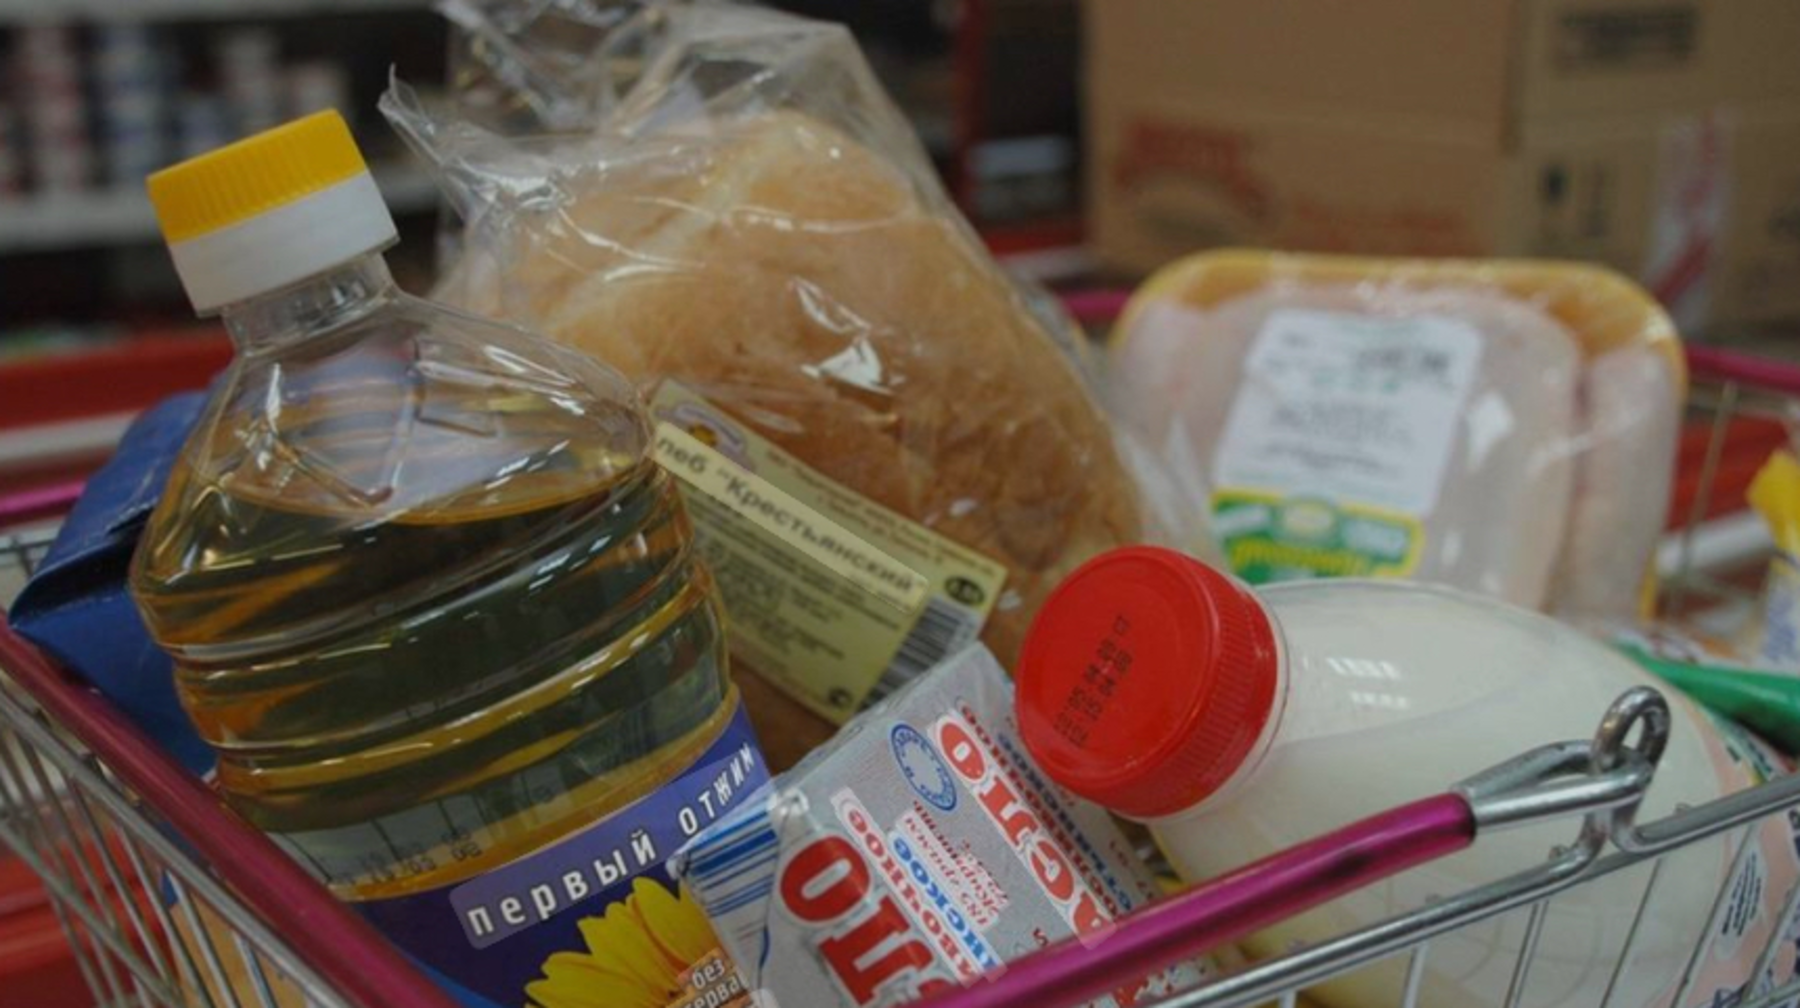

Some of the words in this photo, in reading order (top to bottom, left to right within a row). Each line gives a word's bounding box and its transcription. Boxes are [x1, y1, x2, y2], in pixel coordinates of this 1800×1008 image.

[655, 435, 707, 475] леб
[467, 829, 657, 937] первый
[678, 742, 755, 836] отжим
[939, 721, 1113, 936] асло
[893, 837, 998, 970] нское
[692, 957, 726, 990] без
